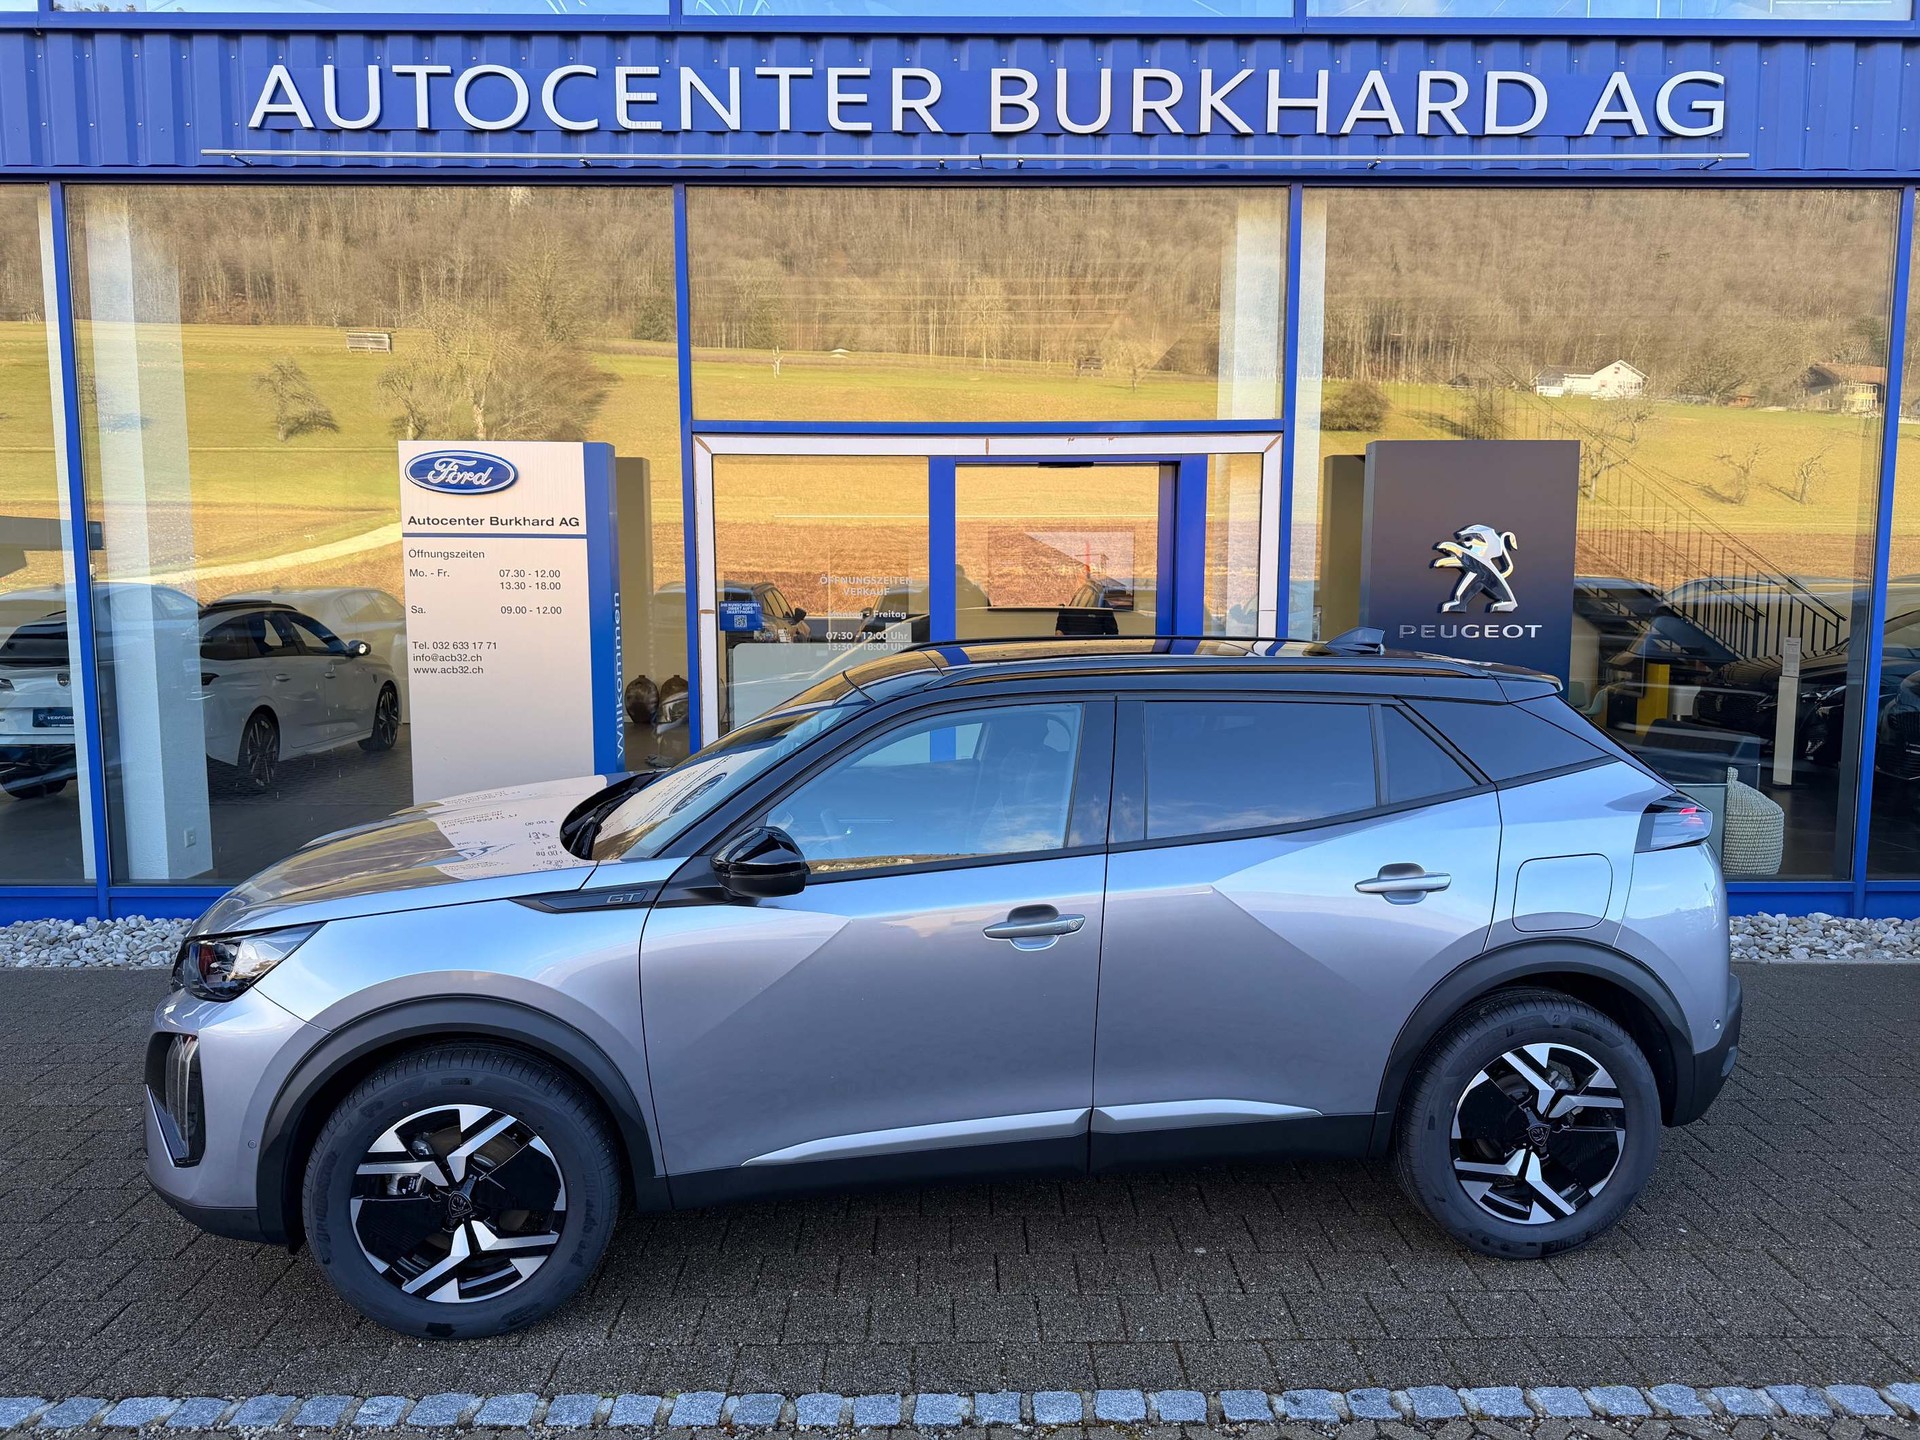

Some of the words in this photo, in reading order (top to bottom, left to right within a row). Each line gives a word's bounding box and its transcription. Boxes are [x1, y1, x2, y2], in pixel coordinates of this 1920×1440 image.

[248, 63, 944, 134] AUTOCENTER
[988, 67, 1550, 137] BURKHARD
[1582, 69, 1727, 139] AG
[427, 457, 493, 487] Ford
[407, 515, 485, 527] Autocenter
[489, 515, 555, 528] Burkhard
[558, 516, 580, 528] AG
[408, 548, 485, 560] Öffnungszeiten
[409, 568, 428, 578] Mo.
[437, 568, 450, 578] Fr.
[499, 569, 527, 578] 07.30
[534, 569, 561, 578] 12.00
[819, 573, 913, 585] ÖFFNUNGSZEITEN
[499, 581, 527, 590] 13.30
[535, 581, 561, 590] 18.00
[843, 587, 891, 596] VERKAUF
[410, 605, 426, 614] Sa.
[500, 606, 527, 615] 09.00
[536, 606, 562, 615] 12.00
[873, 609, 907, 620] Freitag
[825, 631, 854, 640] 07:30
[862, 631, 889, 640] 12:00
[890, 631, 908, 640] Uhr
[1398, 624, 1543, 639] PEUGEOT
[412, 641, 430, 650] Tel.
[432, 641, 450, 650] 032
[452, 641, 470, 650] 633
[472, 641, 484, 650] 17
[486, 641, 497, 650] 71
[827, 642, 854, 651] 13:30
[863, 642, 889, 651] 18:00
[412, 653, 483, 663] info@acb32.ch
[413, 665, 484, 675] www.acb32.ch
[613, 592, 625, 759] Willkommen
[606, 892, 641, 904] GT
